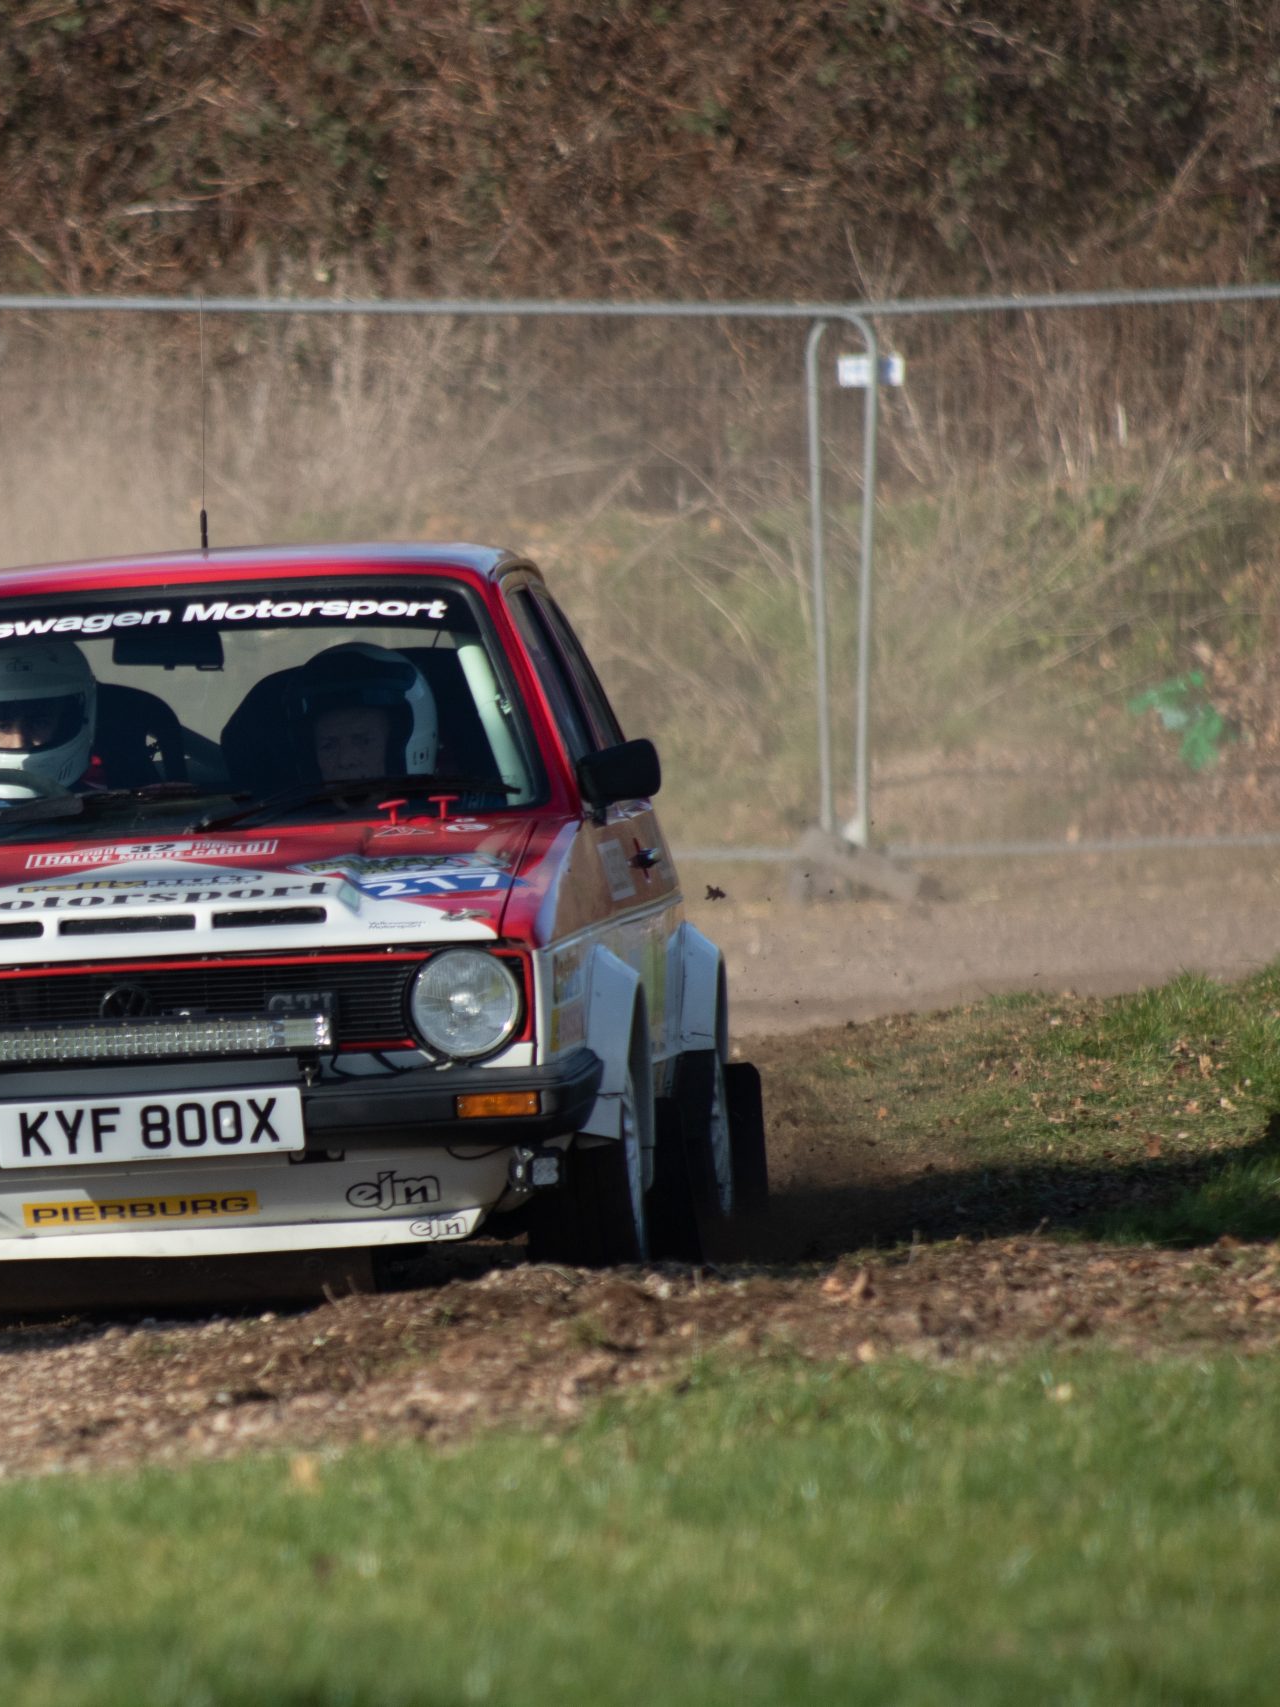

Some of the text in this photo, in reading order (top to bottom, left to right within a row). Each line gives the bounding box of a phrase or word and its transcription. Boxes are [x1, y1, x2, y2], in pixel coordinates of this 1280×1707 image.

[184, 599, 449, 623] Motorsport
[44, 851, 113, 866] RALLYE
[129, 844, 176, 854] 32
[363, 874, 501, 896] 217
[267, 992, 333, 1011] GTI
[19, 1097, 280, 1158] KYF 800X
[345, 1169, 440, 1211] ejm
[32, 1196, 250, 1224] PIERBURG
